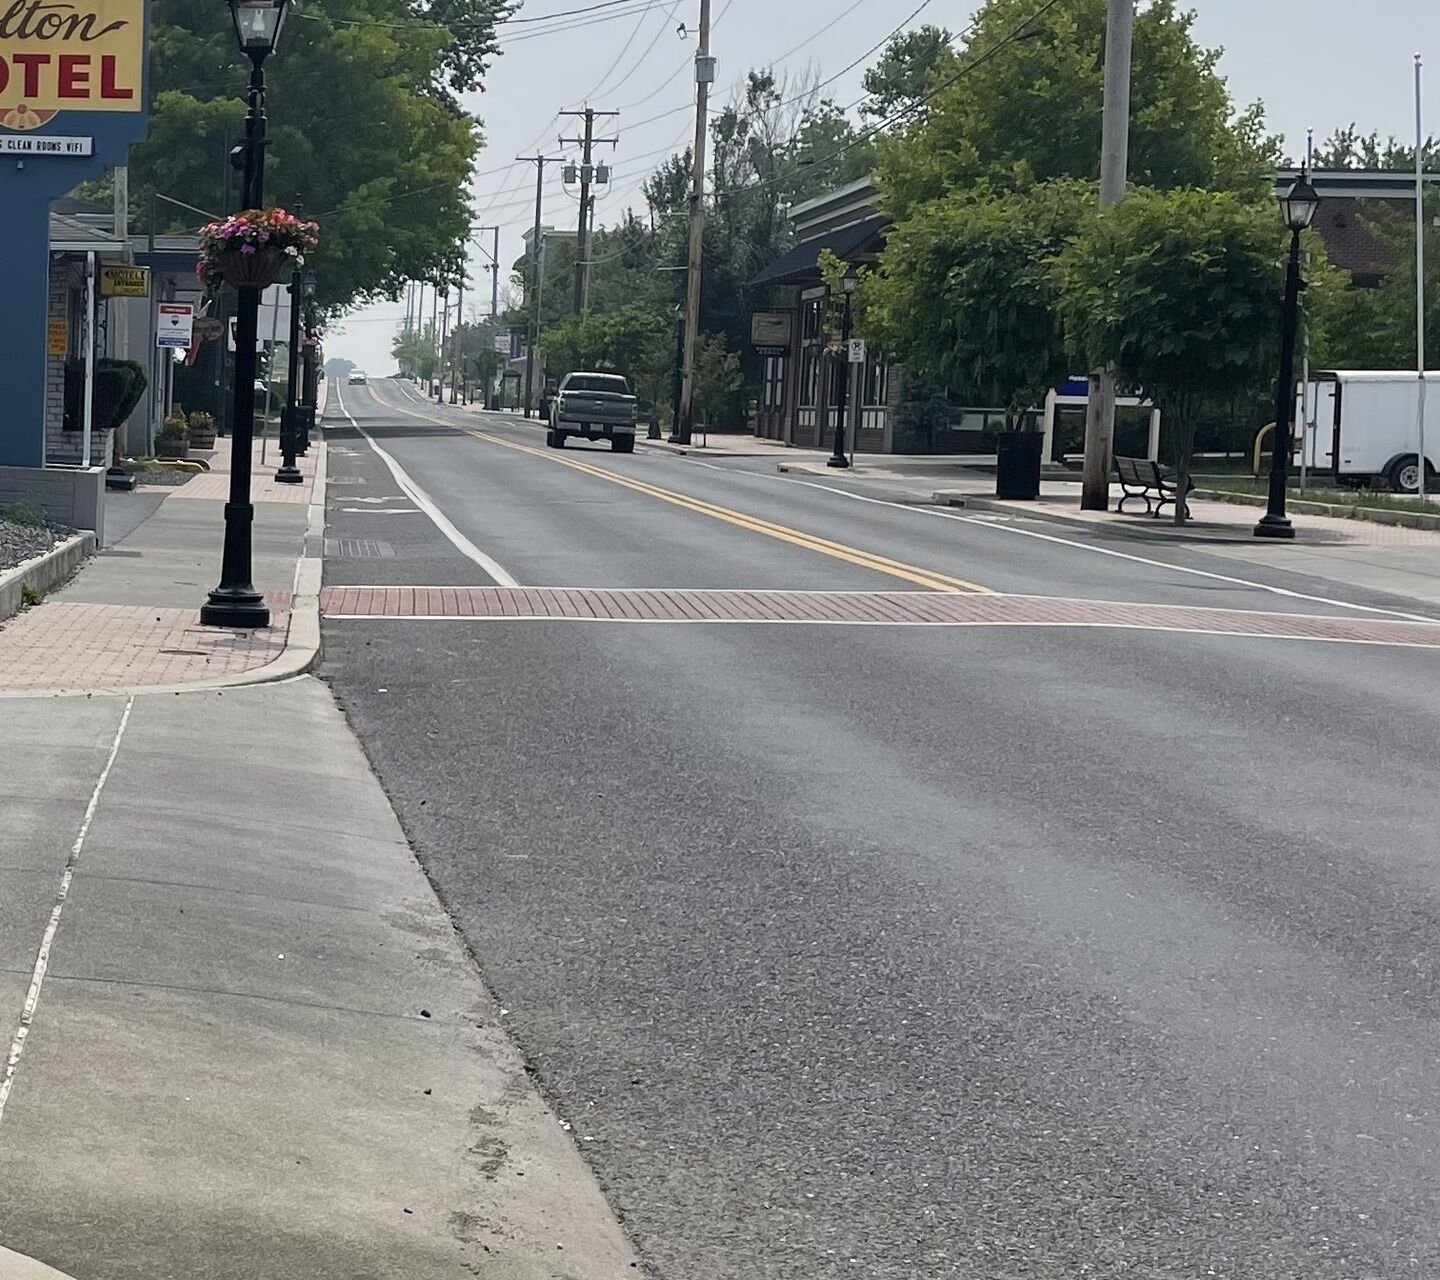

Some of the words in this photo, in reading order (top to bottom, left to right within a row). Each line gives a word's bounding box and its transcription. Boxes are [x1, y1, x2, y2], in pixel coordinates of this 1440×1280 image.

[7, 139, 32, 151] CLEAN
[37, 140, 62, 152] ROOMS
[67, 142, 83, 153] WIFI
[110, 270, 141, 280] MOTEL
